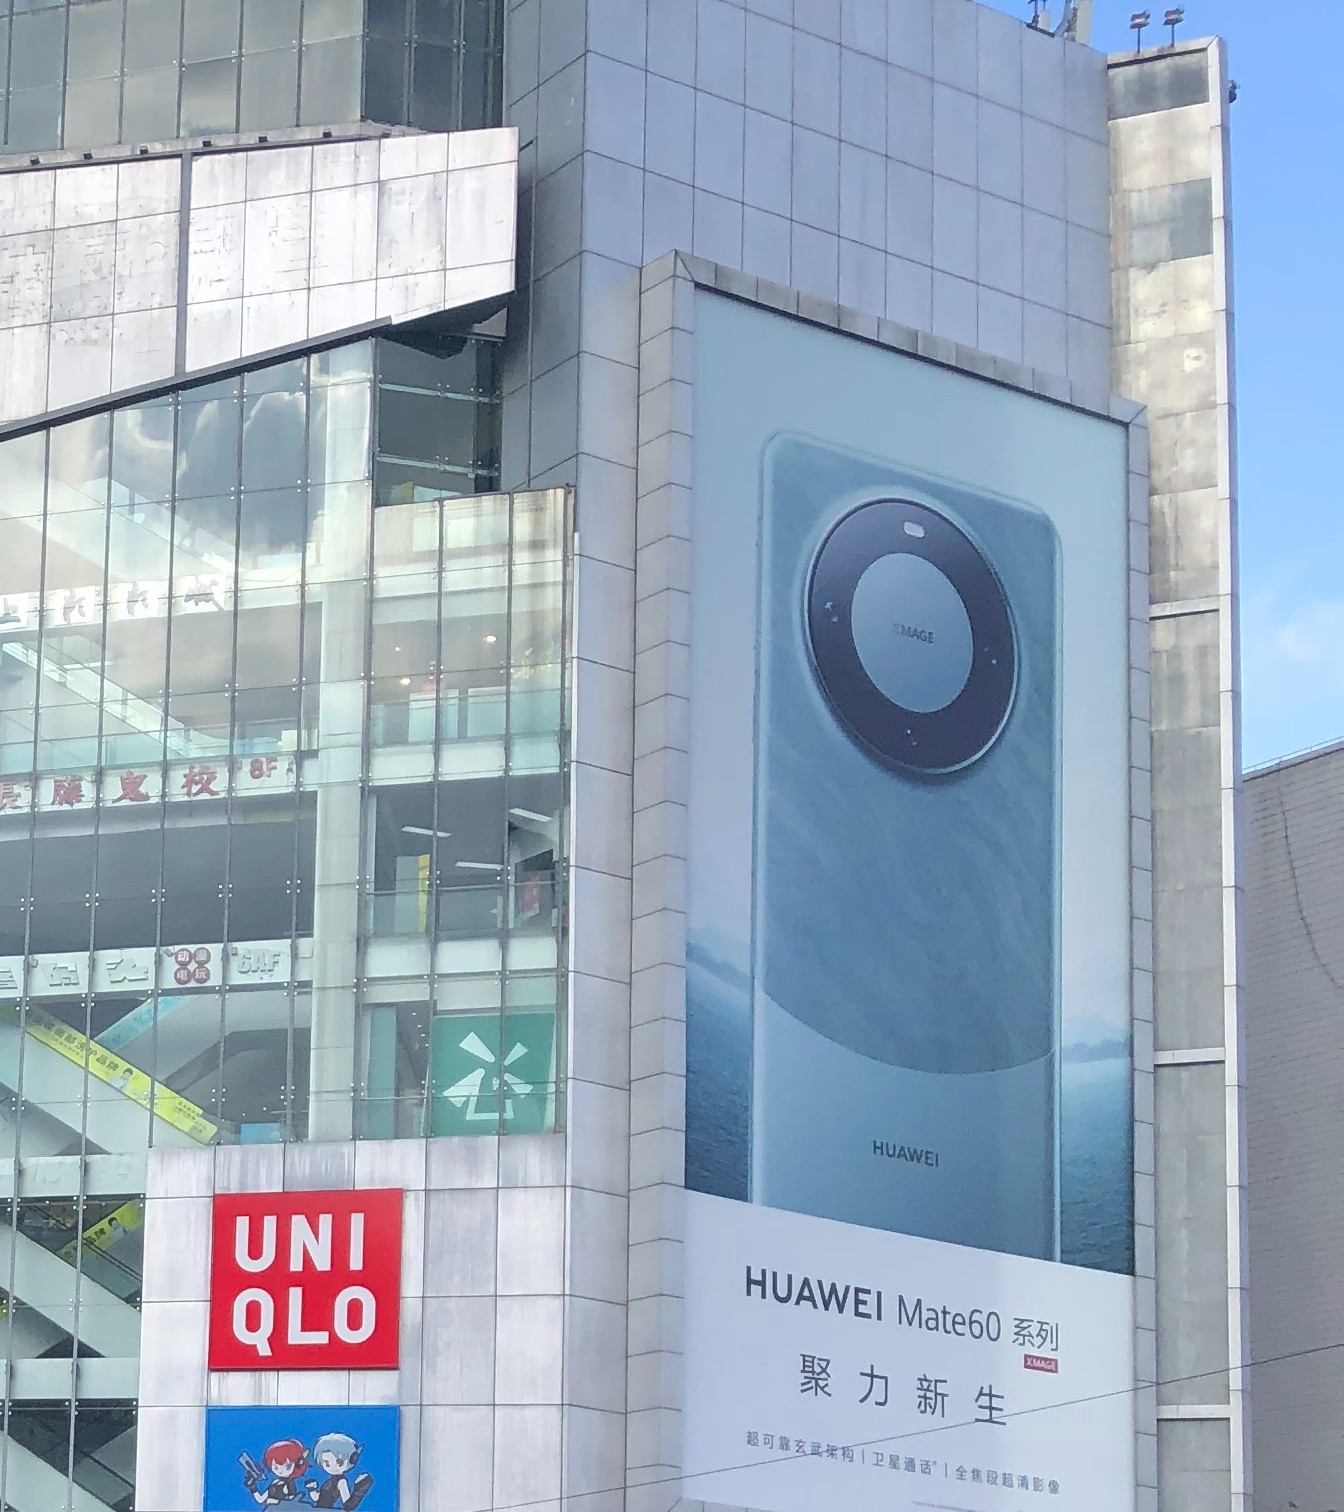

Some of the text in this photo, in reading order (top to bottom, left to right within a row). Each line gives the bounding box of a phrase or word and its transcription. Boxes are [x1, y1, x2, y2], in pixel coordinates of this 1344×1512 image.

[872, 1139, 939, 1167] HUAWEI
[235, 1213, 364, 1272] UNI
[233, 1286, 376, 1356] QLO
[746, 1265, 1059, 1351] HUAWEI Mate60 系列
[799, 1353, 1007, 1426] 聚力新生
